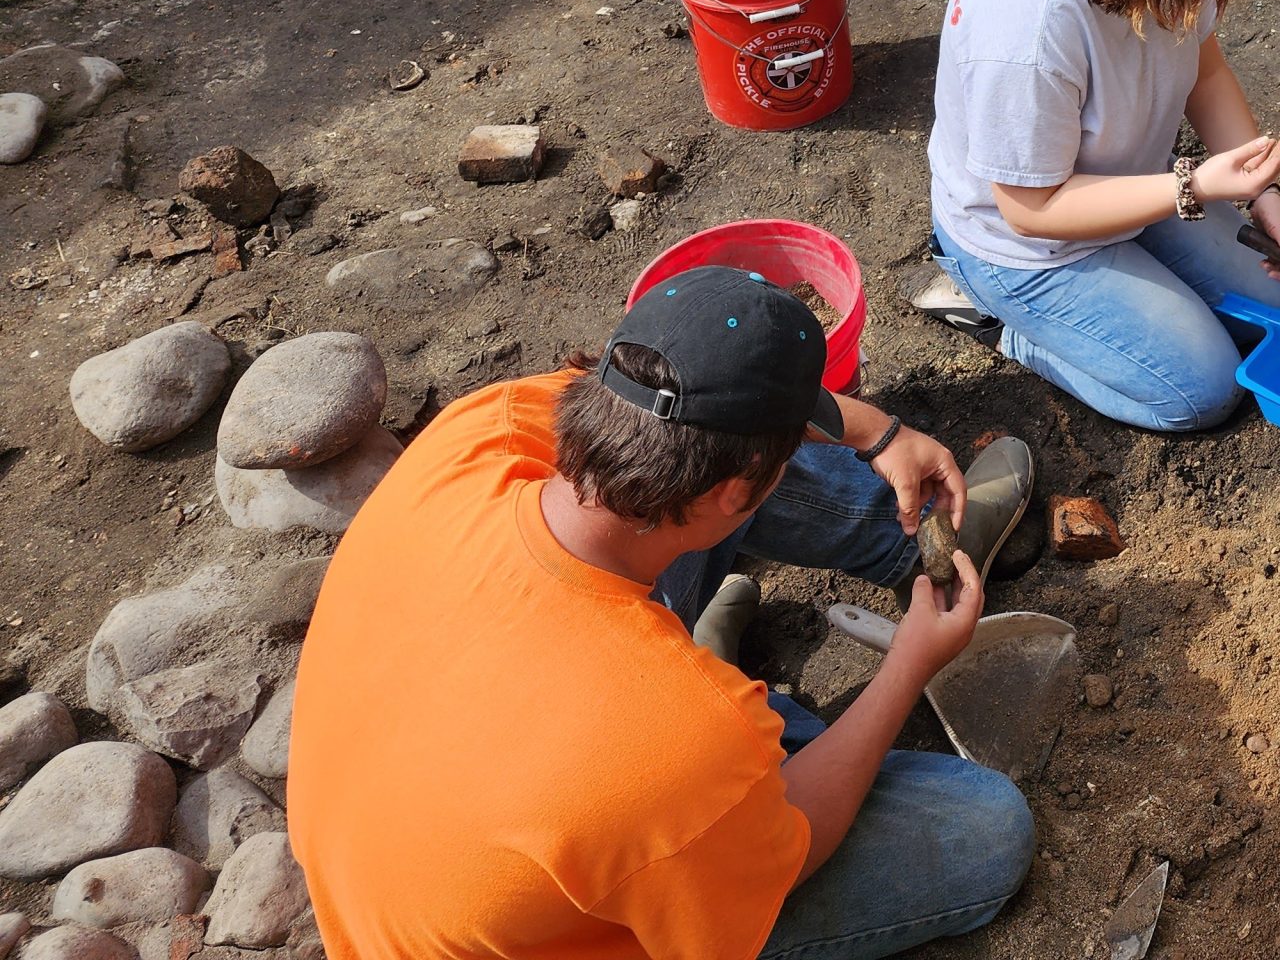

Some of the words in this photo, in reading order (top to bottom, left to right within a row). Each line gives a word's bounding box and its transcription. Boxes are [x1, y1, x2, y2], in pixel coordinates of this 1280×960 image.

[767, 25, 826, 41] OFFICIAL
[763, 37, 811, 53] FIREHOUSE
[736, 63, 771, 108] PICKLE
